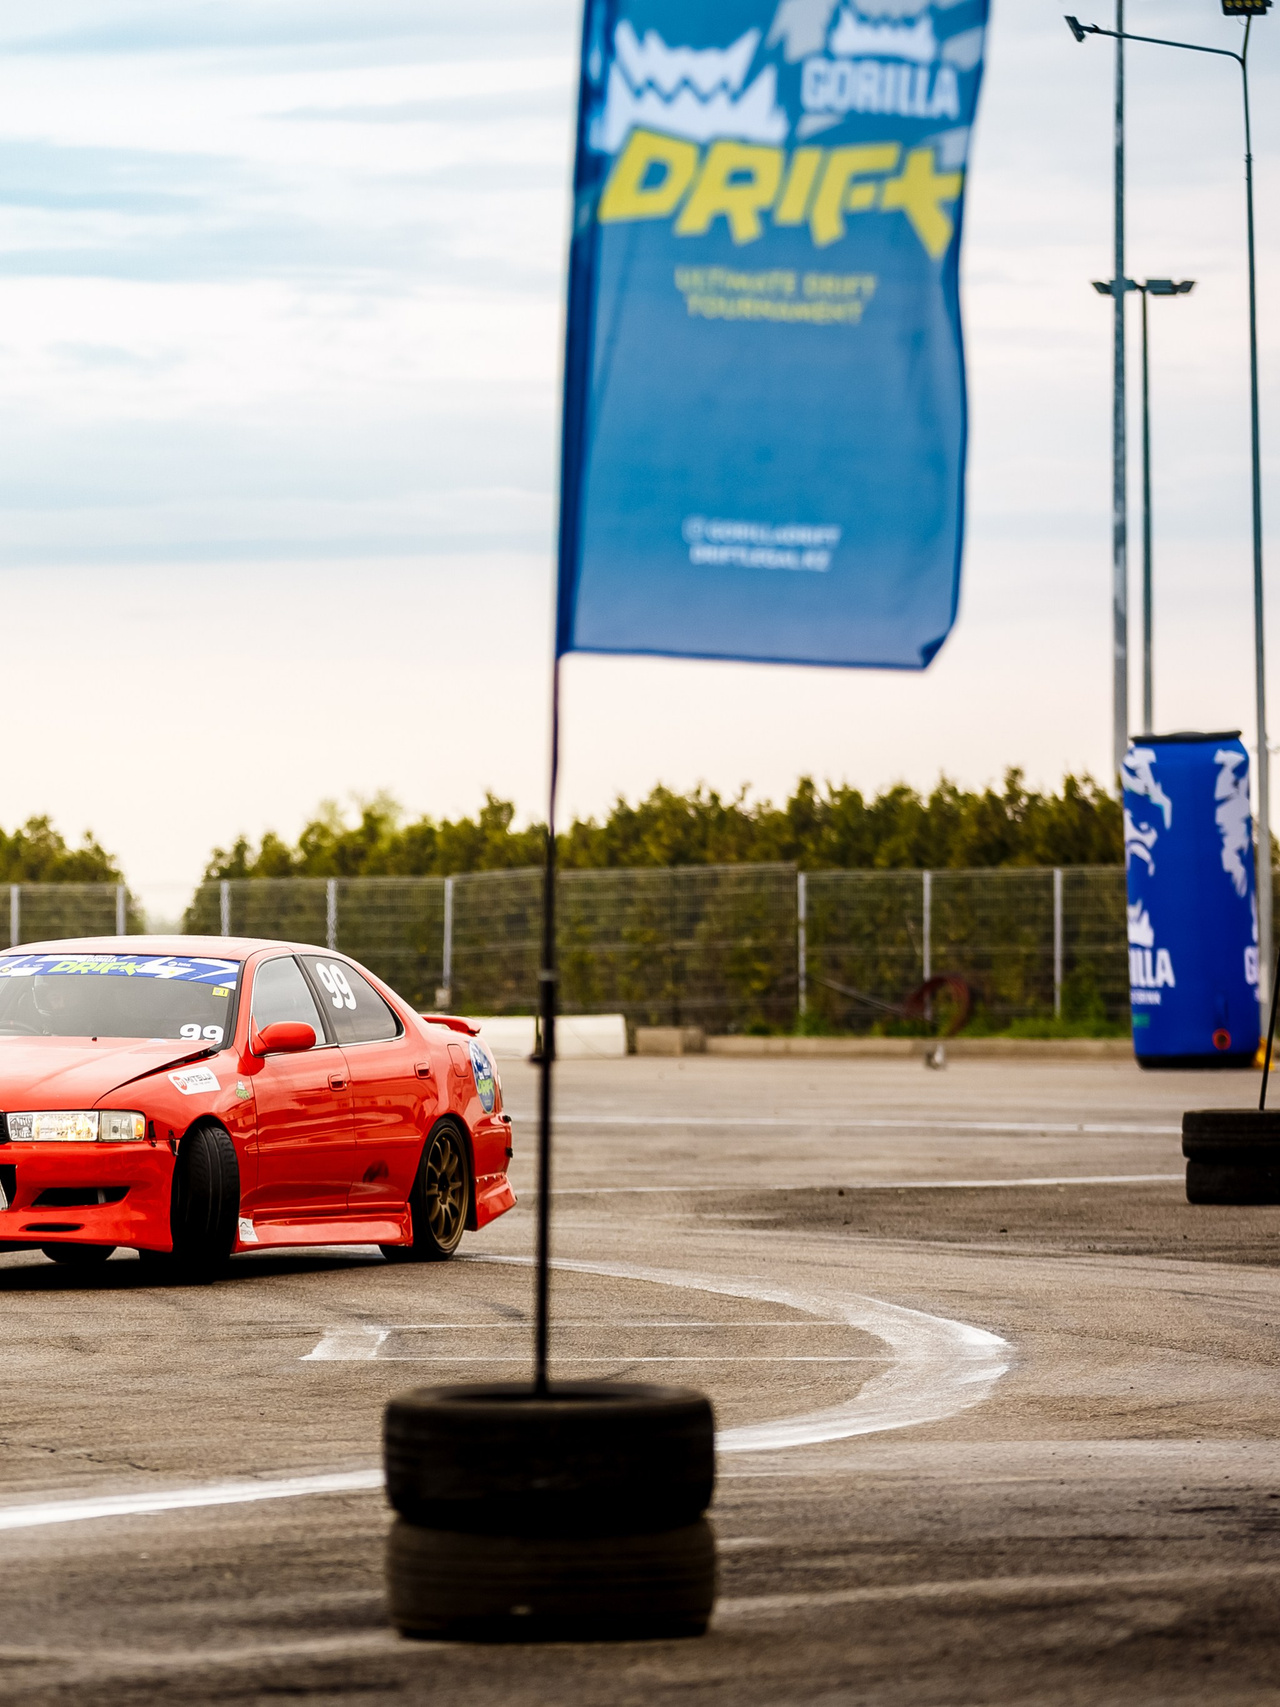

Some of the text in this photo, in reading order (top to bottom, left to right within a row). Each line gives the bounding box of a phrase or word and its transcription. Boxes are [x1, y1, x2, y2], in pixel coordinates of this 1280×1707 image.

[800, 57, 960, 119] GORILLA
[597, 127, 963, 260] DRIFT
[47, 961, 142, 976] DRIFT
[316, 962, 357, 1011] 99
[180, 1023, 224, 1045] 99
